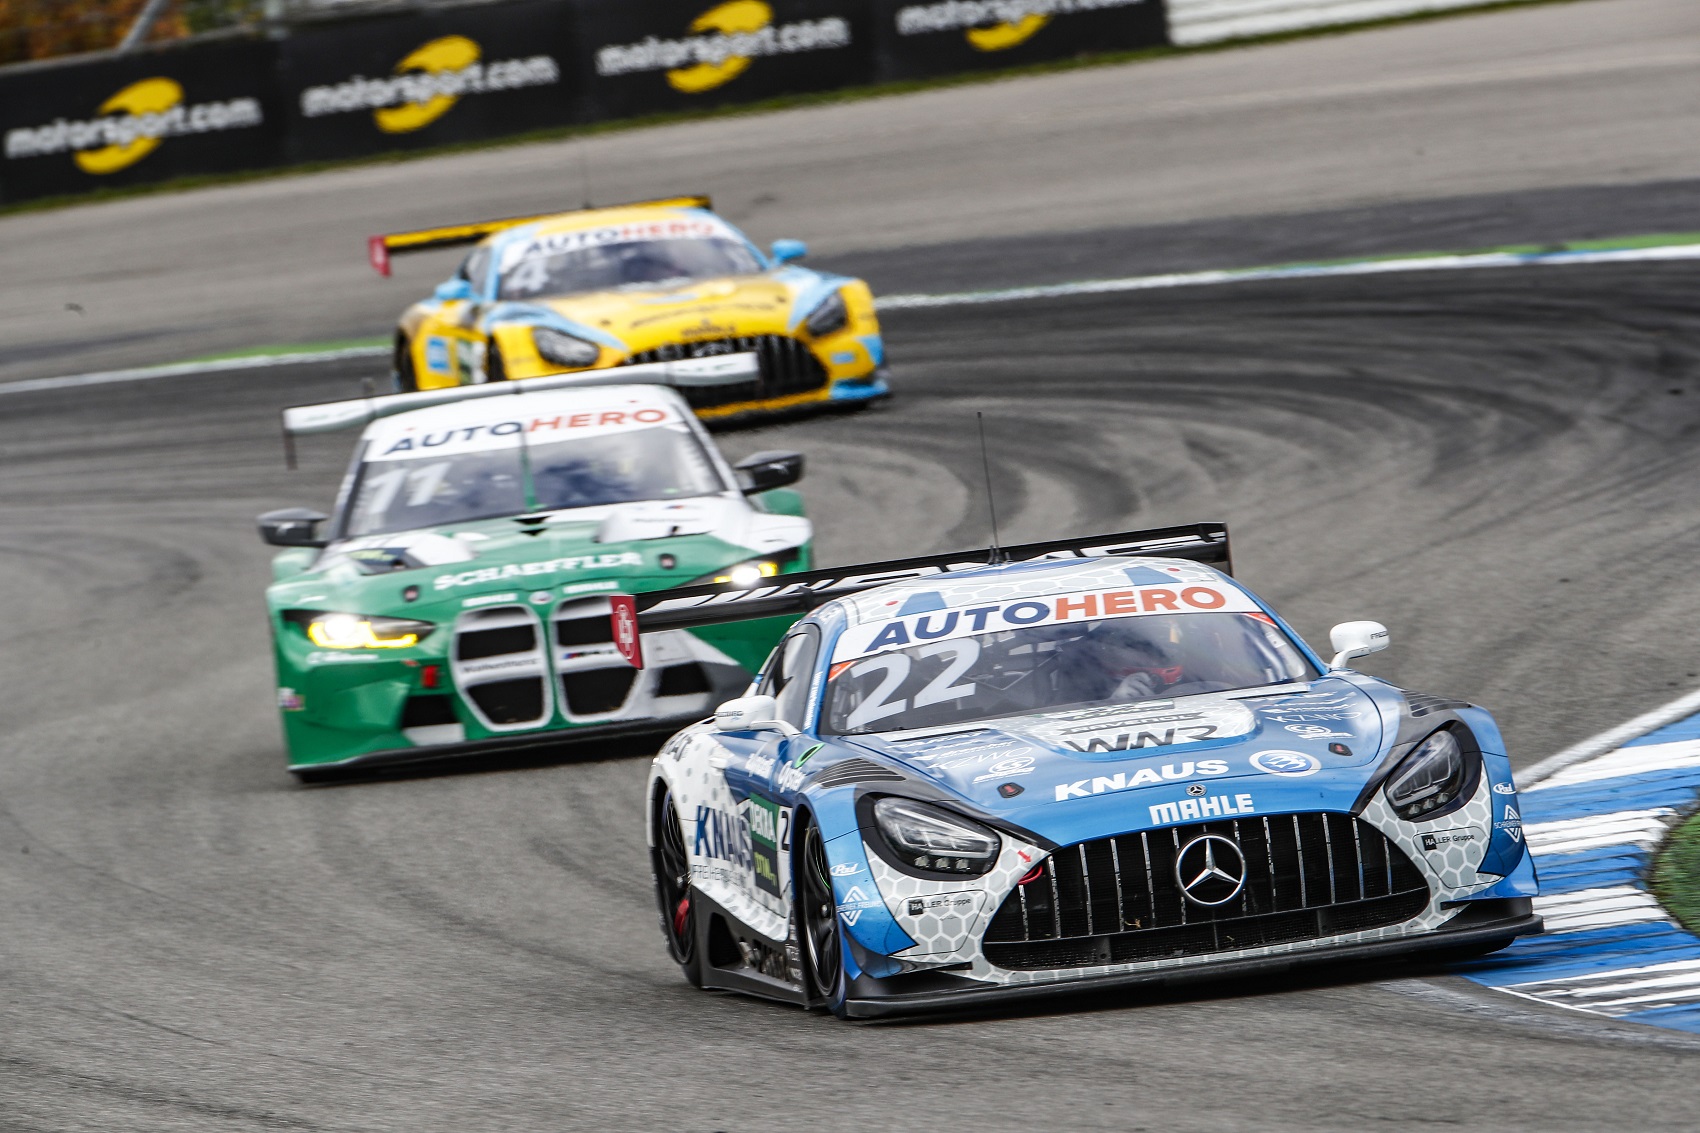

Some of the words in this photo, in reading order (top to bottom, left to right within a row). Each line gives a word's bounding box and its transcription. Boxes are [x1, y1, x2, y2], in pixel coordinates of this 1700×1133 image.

[596, 16, 850, 76] motorsport.com
[301, 55, 560, 118] motorsport.com
[5, 97, 263, 158] motorsport.com
[526, 222, 714, 253] AUTOHERO
[504, 254, 549, 292] 4
[383, 409, 667, 455] AUTOHERO
[368, 462, 452, 515] 11
[434, 553, 641, 590] SCHAEFFLER
[864, 586, 1226, 653] AUTOHERO
[846, 638, 981, 731] 22
[1055, 760, 1230, 801] KNAUS
[1148, 794, 1254, 825] MAHLE
